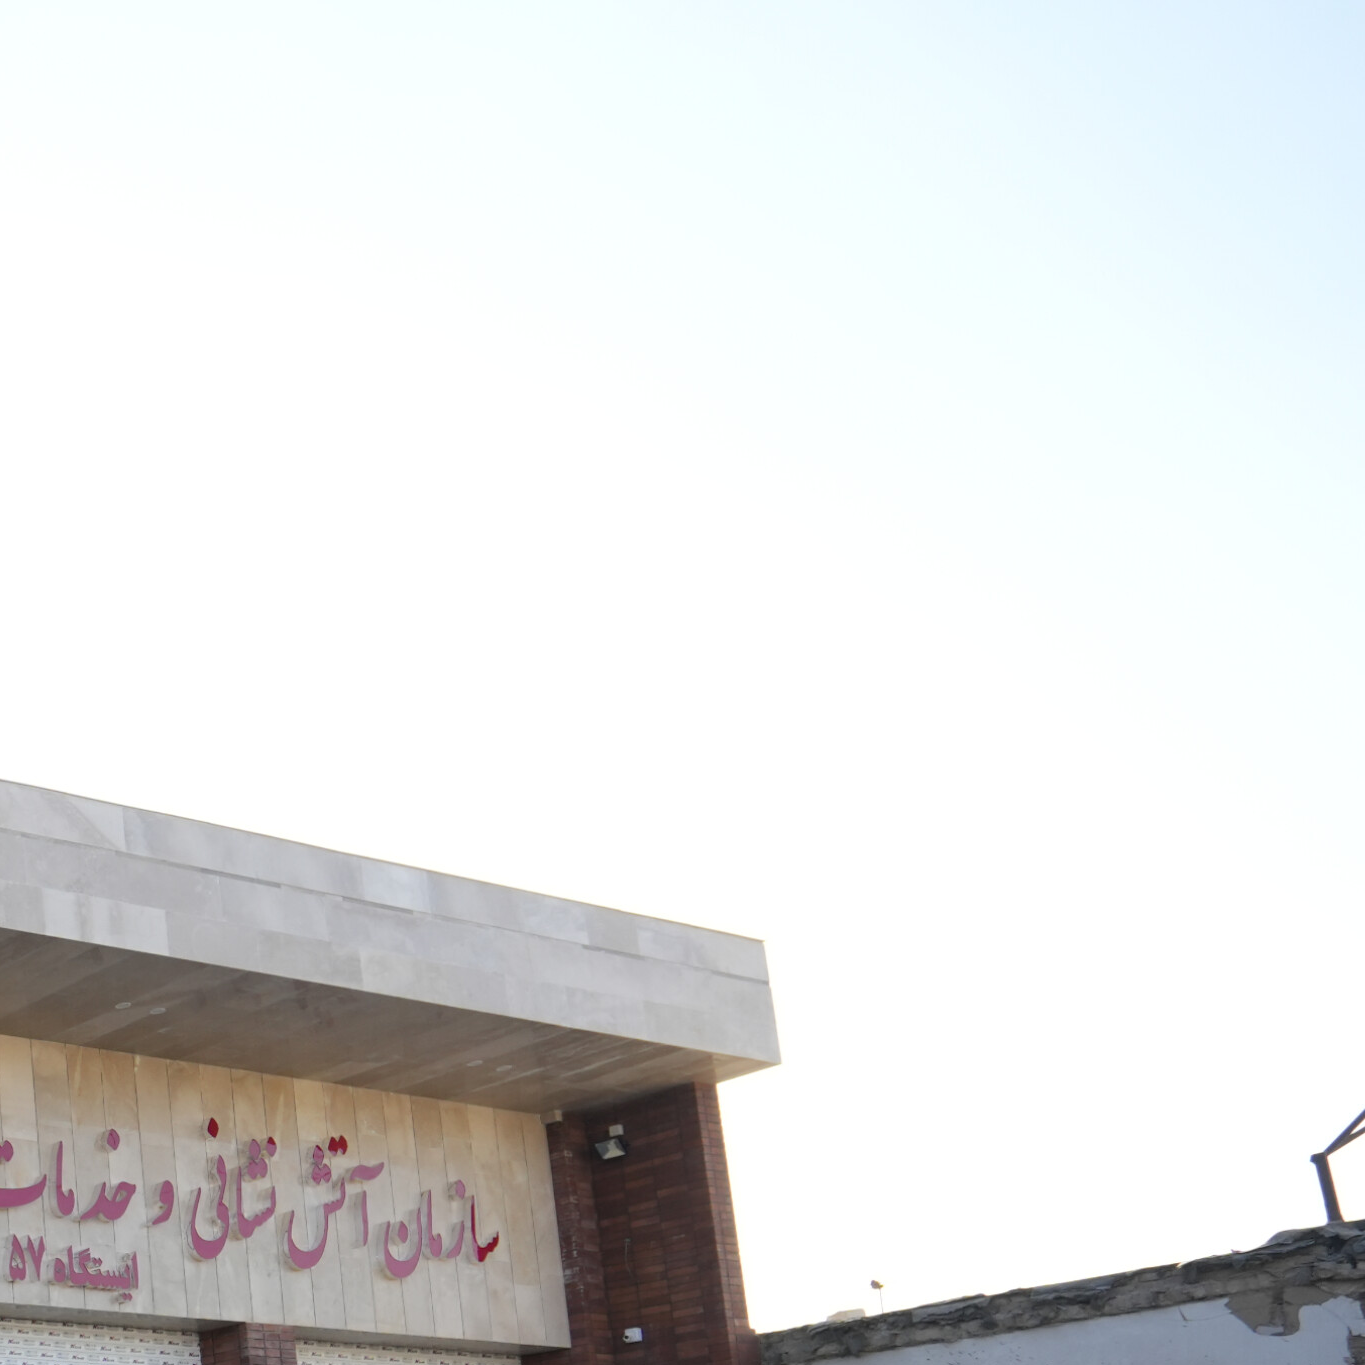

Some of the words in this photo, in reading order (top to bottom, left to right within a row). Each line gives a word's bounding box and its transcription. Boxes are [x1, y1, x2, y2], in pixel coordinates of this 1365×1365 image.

[151, 1179, 175, 1226] و
[189, 1116, 277, 1260] نشانی
[286, 1134, 385, 1270] آتش
[7, 1233, 46, 1282] ۵۷
[381, 1179, 500, 1279] سازمان
[51, 1244, 139, 1302] ایستگاه
